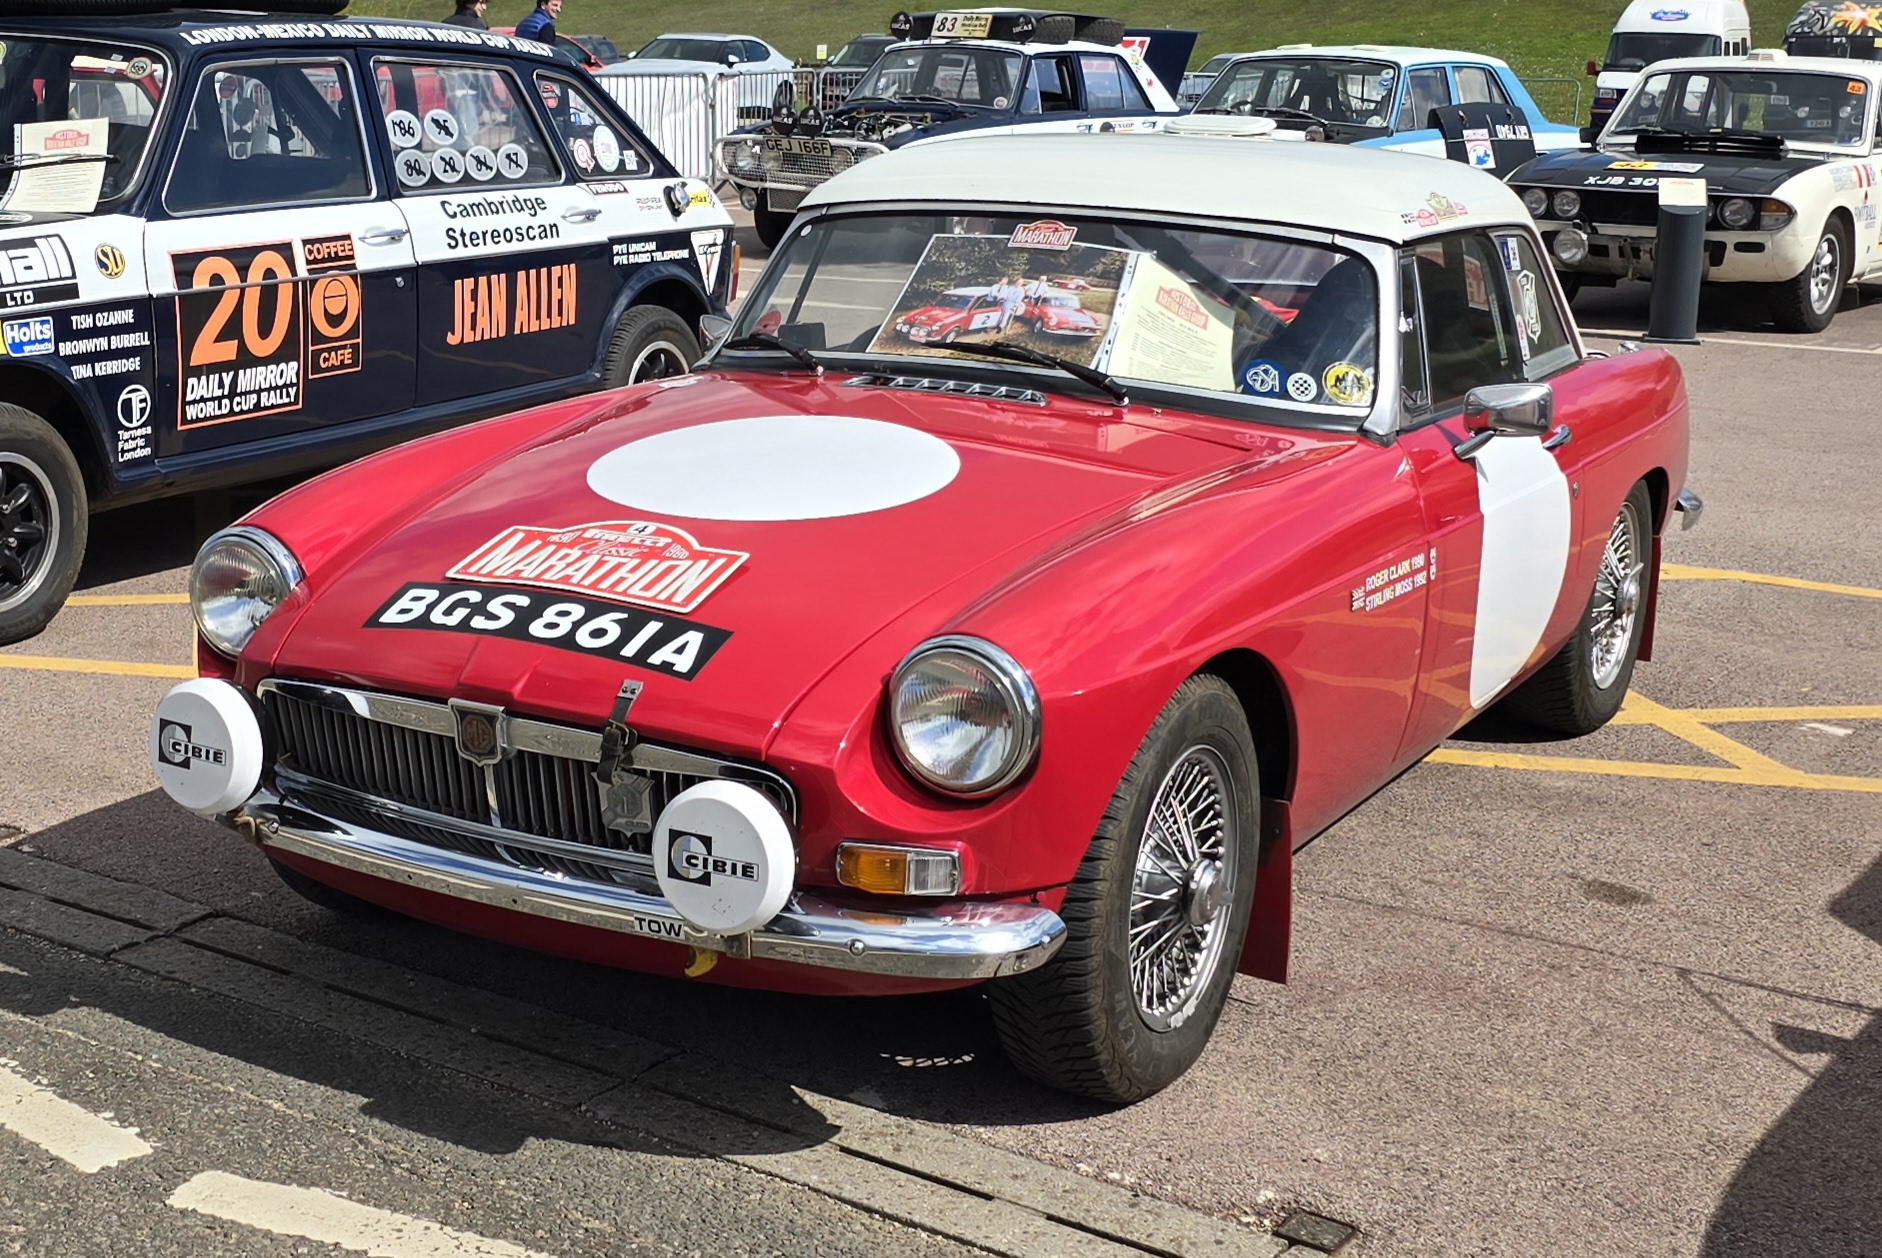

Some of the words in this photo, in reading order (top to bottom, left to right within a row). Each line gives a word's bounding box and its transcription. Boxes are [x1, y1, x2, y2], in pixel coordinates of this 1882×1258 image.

[891, 22, 910, 30] LUCAS
[937, 17, 957, 32] 83
[1012, 24, 1032, 33] LUCAS
[179, 23, 325, 45] LONDON-MEXICO
[322, 23, 372, 39] DAILY
[369, 24, 434, 42] MIRROR
[427, 27, 482, 45] WORLD
[480, 33, 511, 50] CUP
[508, 38, 553, 57] RALLY
[1848, 84, 1862, 93] 43
[765, 139, 793, 151] GEJ
[797, 140, 829, 154] 166F
[1583, 176, 1626, 185] XJB
[1628, 177, 1660, 187] 30
[440, 194, 547, 219] Cambridge
[445, 222, 560, 250] Stereoscan
[1013, 226, 1073, 246] MARATHON
[304, 240, 354, 260] COFFEE
[612, 244, 627, 255] PYE
[613, 255, 628, 266] PYE
[6, 290, 35, 307] LTD
[189, 250, 294, 367] 20
[446, 272, 507, 346] JEAN
[513, 263, 577, 336] ALLEN
[71, 313, 94, 331] TISH
[95, 309, 135, 328] OZANNE
[981, 314, 991, 325] 2
[5, 321, 52, 345] Holts
[22, 341, 52, 354] products
[58, 335, 109, 357] BRONWYN
[110, 331, 151, 349] BURRELL
[71, 363, 94, 381] TINA
[95, 356, 141, 377] KERRIDGE
[185, 370, 235, 402] DAILY
[236, 360, 299, 395] MIRROR
[185, 398, 231, 421] WORLD
[232, 393, 258, 413] CUP
[260, 386, 298, 408] RALLY
[117, 437, 145, 452] Fabric
[118, 447, 151, 463] London
[634, 525, 650, 534] 4
[466, 531, 728, 605] MARATHON
[1365, 568, 1389, 593] ROGER
[1389, 558, 1411, 581] CLARK
[1365, 585, 1395, 612] STIRLING
[1394, 576, 1413, 597] MOSS
[377, 587, 532, 631] BGS
[528, 602, 705, 675] 861A
[634, 916, 683, 938] TOW
